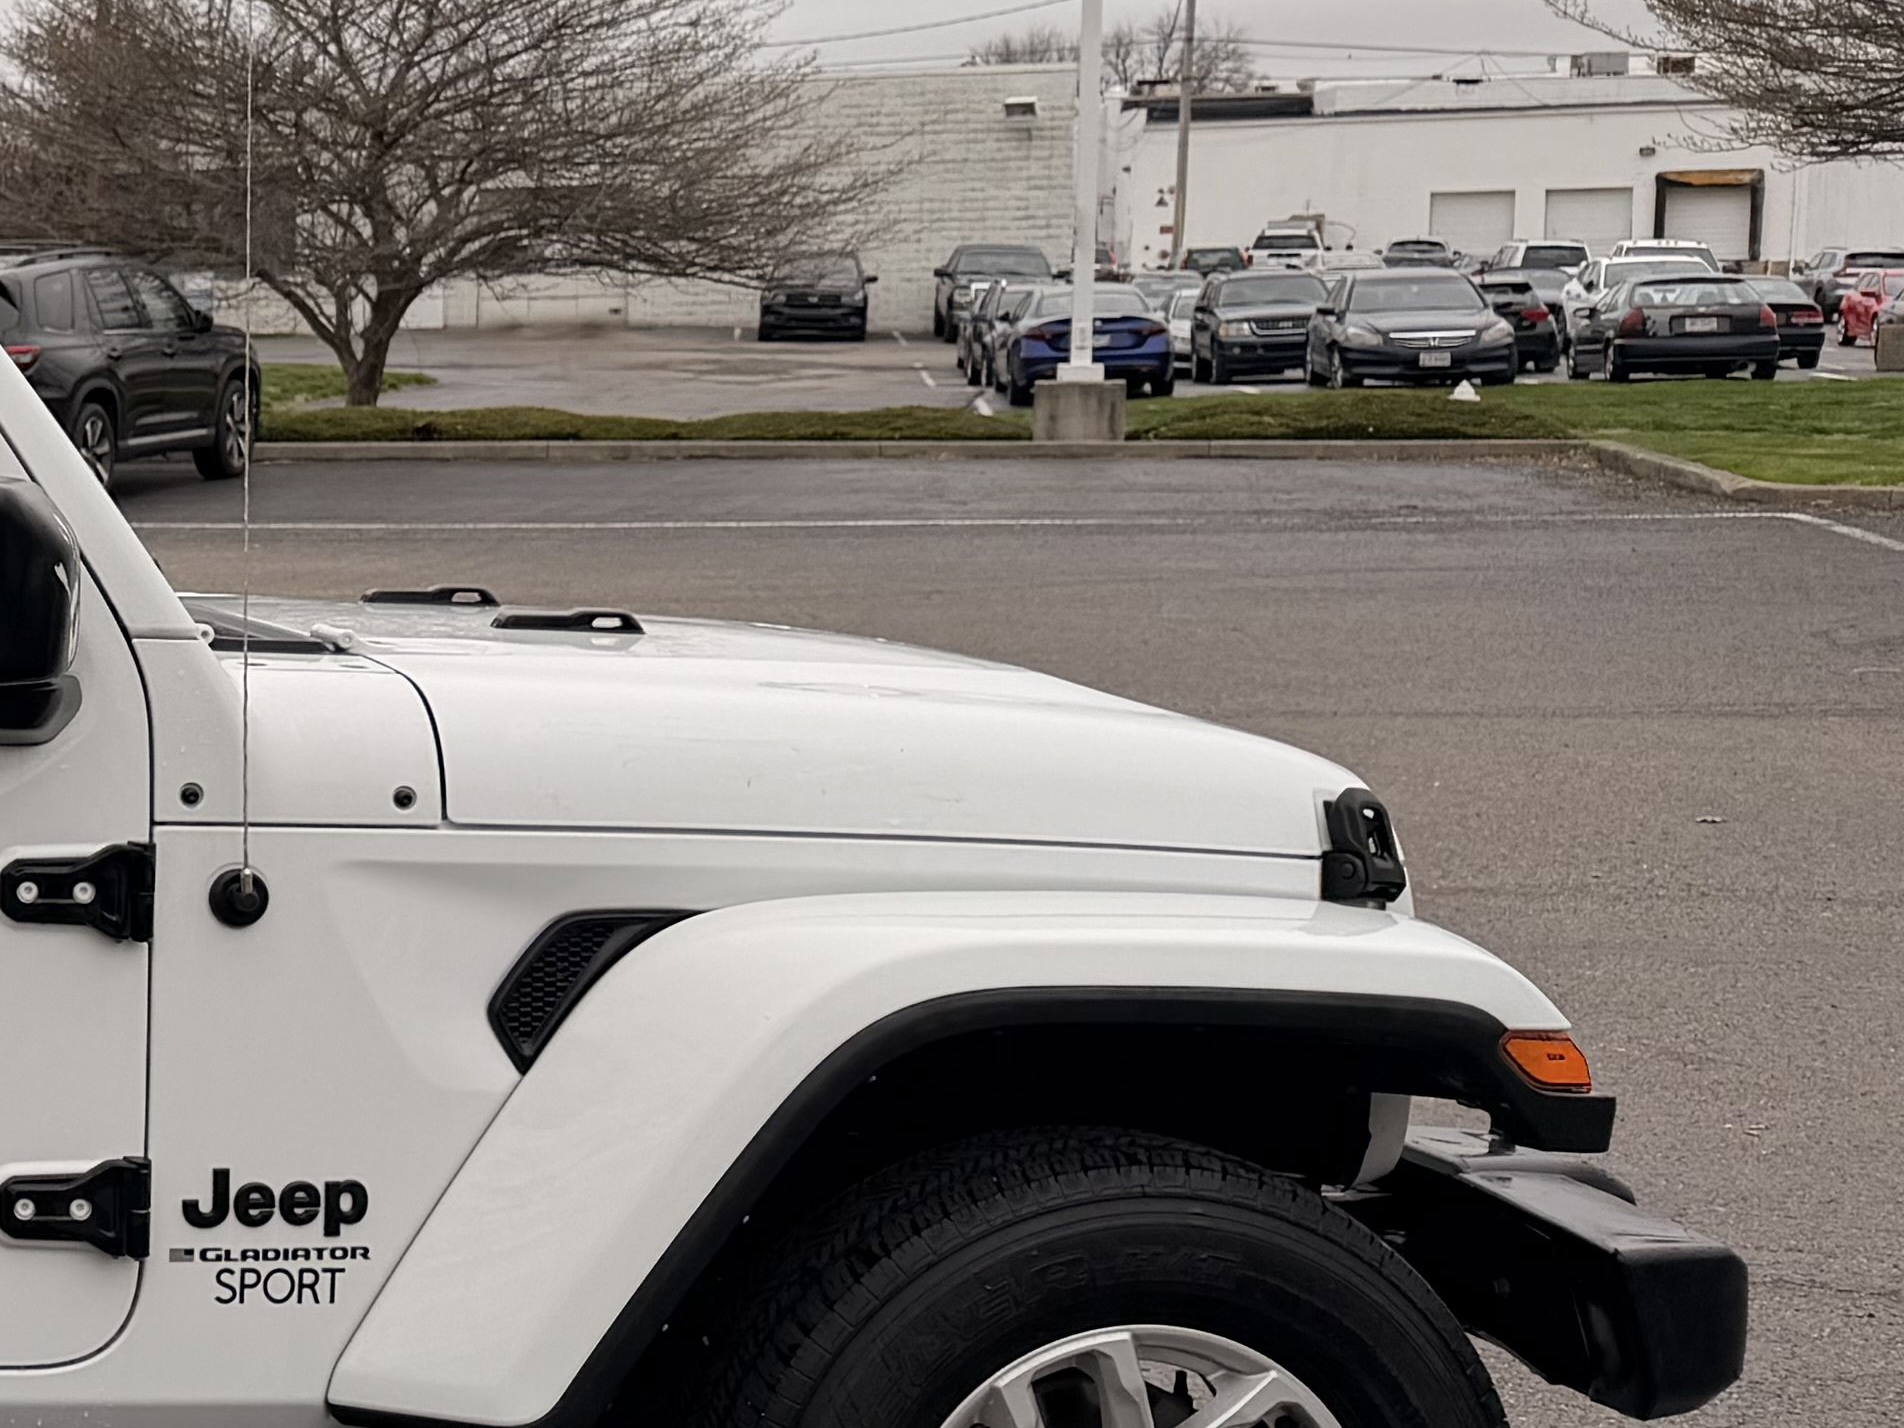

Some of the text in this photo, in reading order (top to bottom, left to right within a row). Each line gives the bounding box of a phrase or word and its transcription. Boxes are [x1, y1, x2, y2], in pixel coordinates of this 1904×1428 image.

[182, 1168, 369, 1237] Jeep
[199, 1246, 372, 1262] GLADIATOR
[214, 1267, 346, 1304] SPORT
